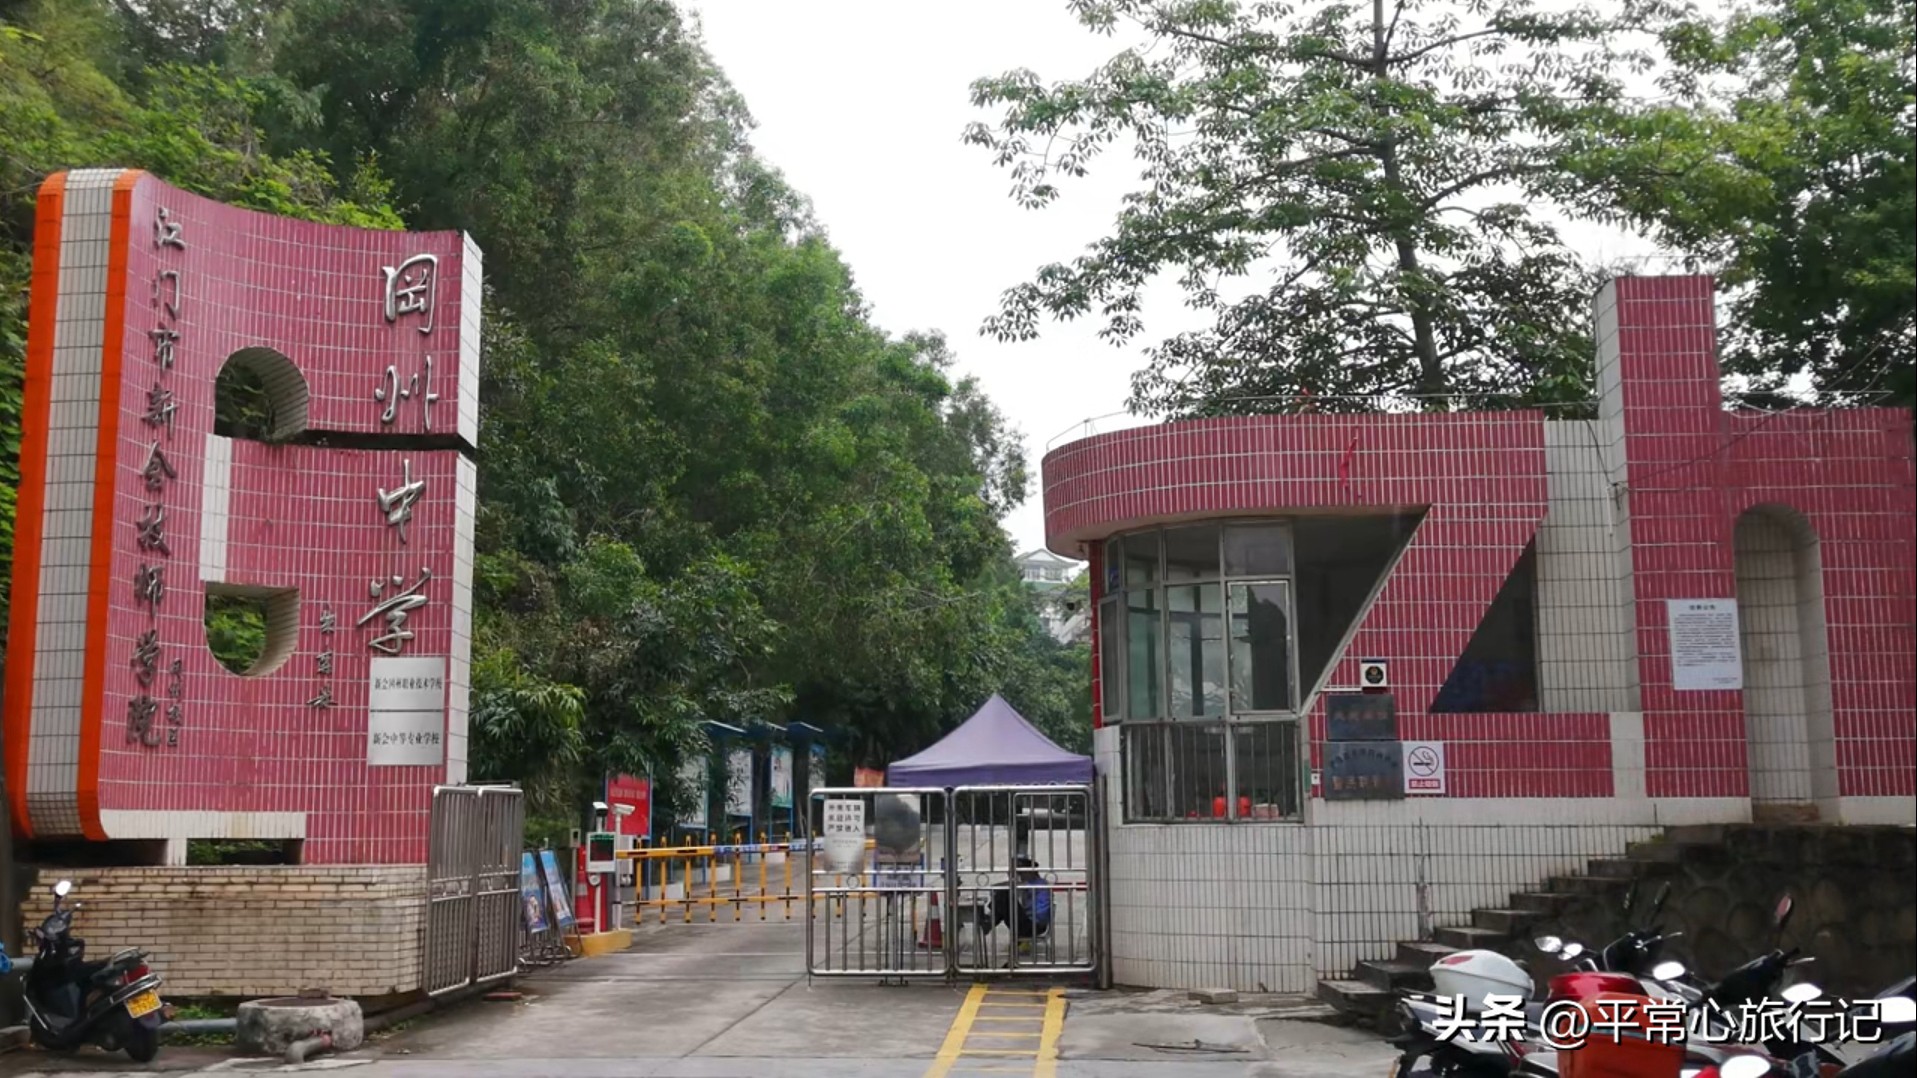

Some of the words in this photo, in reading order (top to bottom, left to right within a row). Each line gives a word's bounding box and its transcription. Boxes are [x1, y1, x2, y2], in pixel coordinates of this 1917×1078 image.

[373, 732, 440, 745] 新会中等专业学校
[828, 804, 861, 812] 外来车辆
[828, 814, 861, 822] 未经许可
[828, 823, 861, 832] 严禁进入
